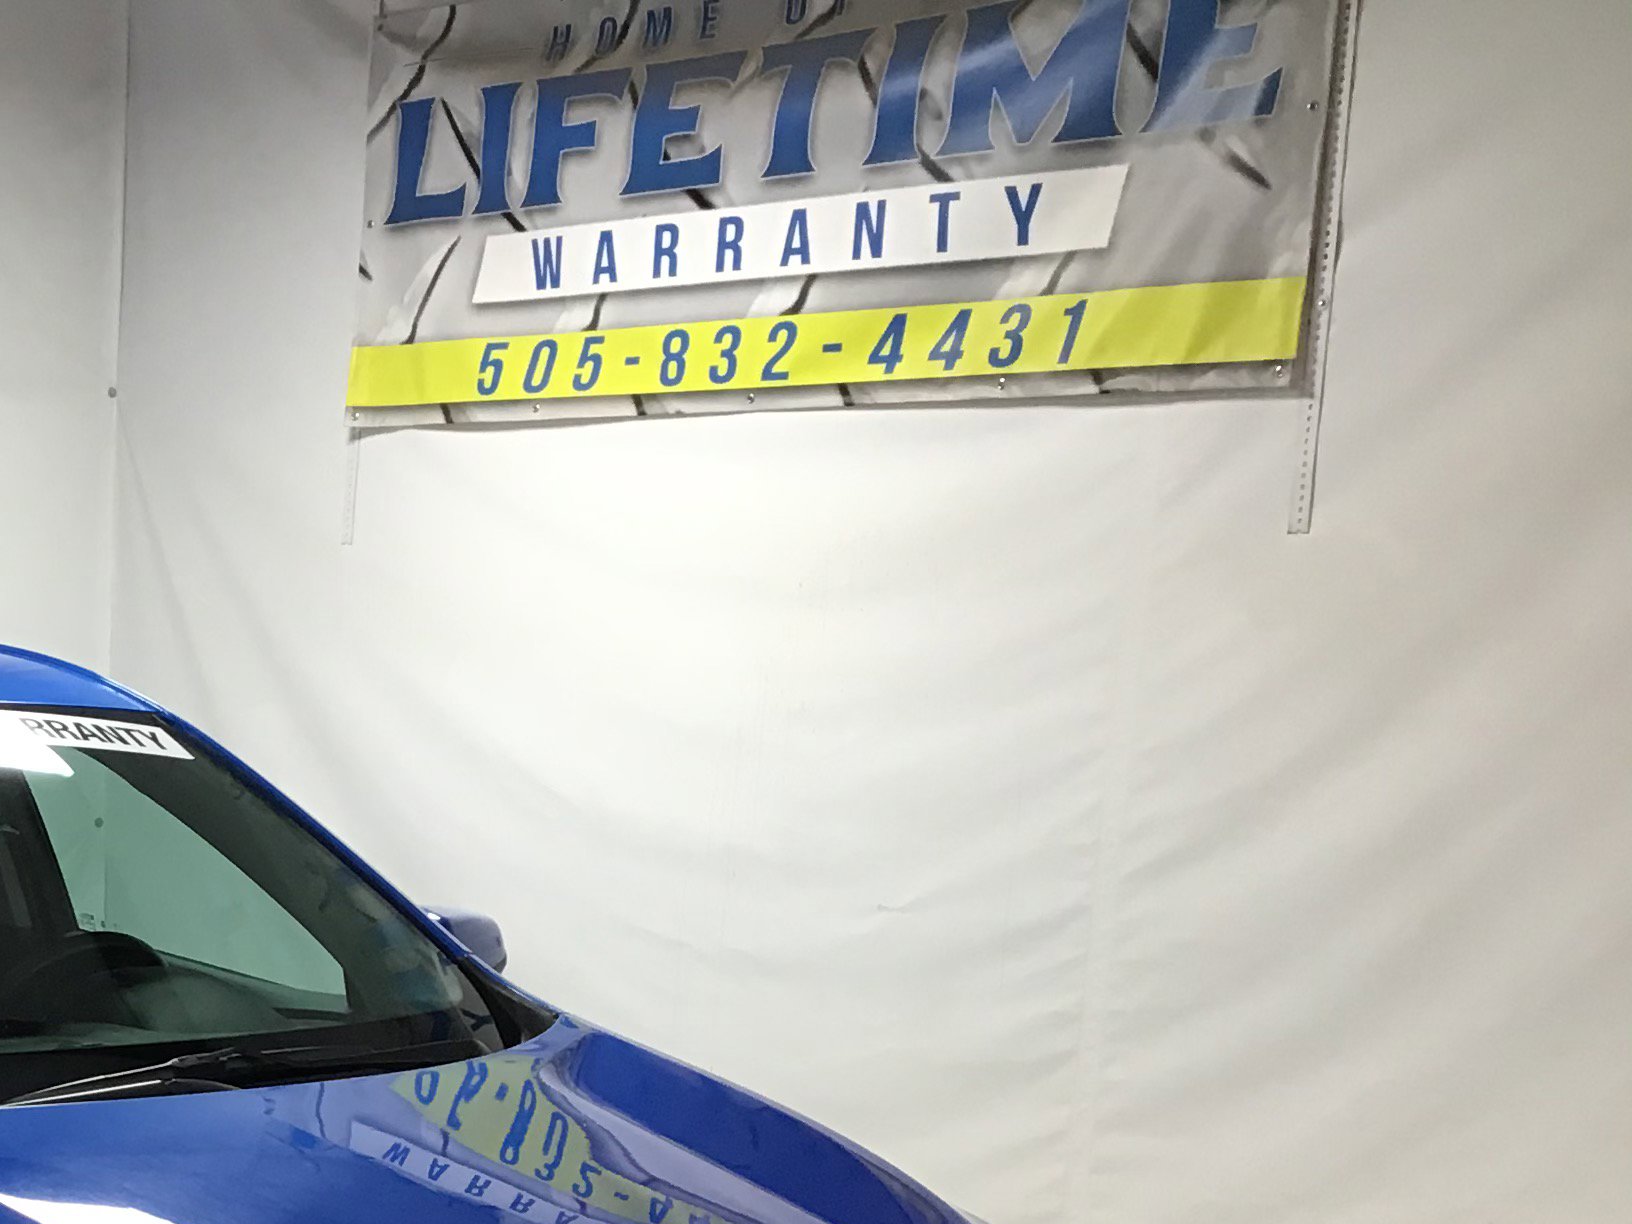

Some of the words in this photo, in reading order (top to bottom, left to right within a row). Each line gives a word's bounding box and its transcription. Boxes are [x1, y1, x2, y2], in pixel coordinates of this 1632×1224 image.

[546, 2, 718, 62] HOME
[385, 0, 1283, 226] LIFETIME
[531, 183, 1043, 291] WARRANTY
[477, 299, 1088, 396] 505-832-4431
